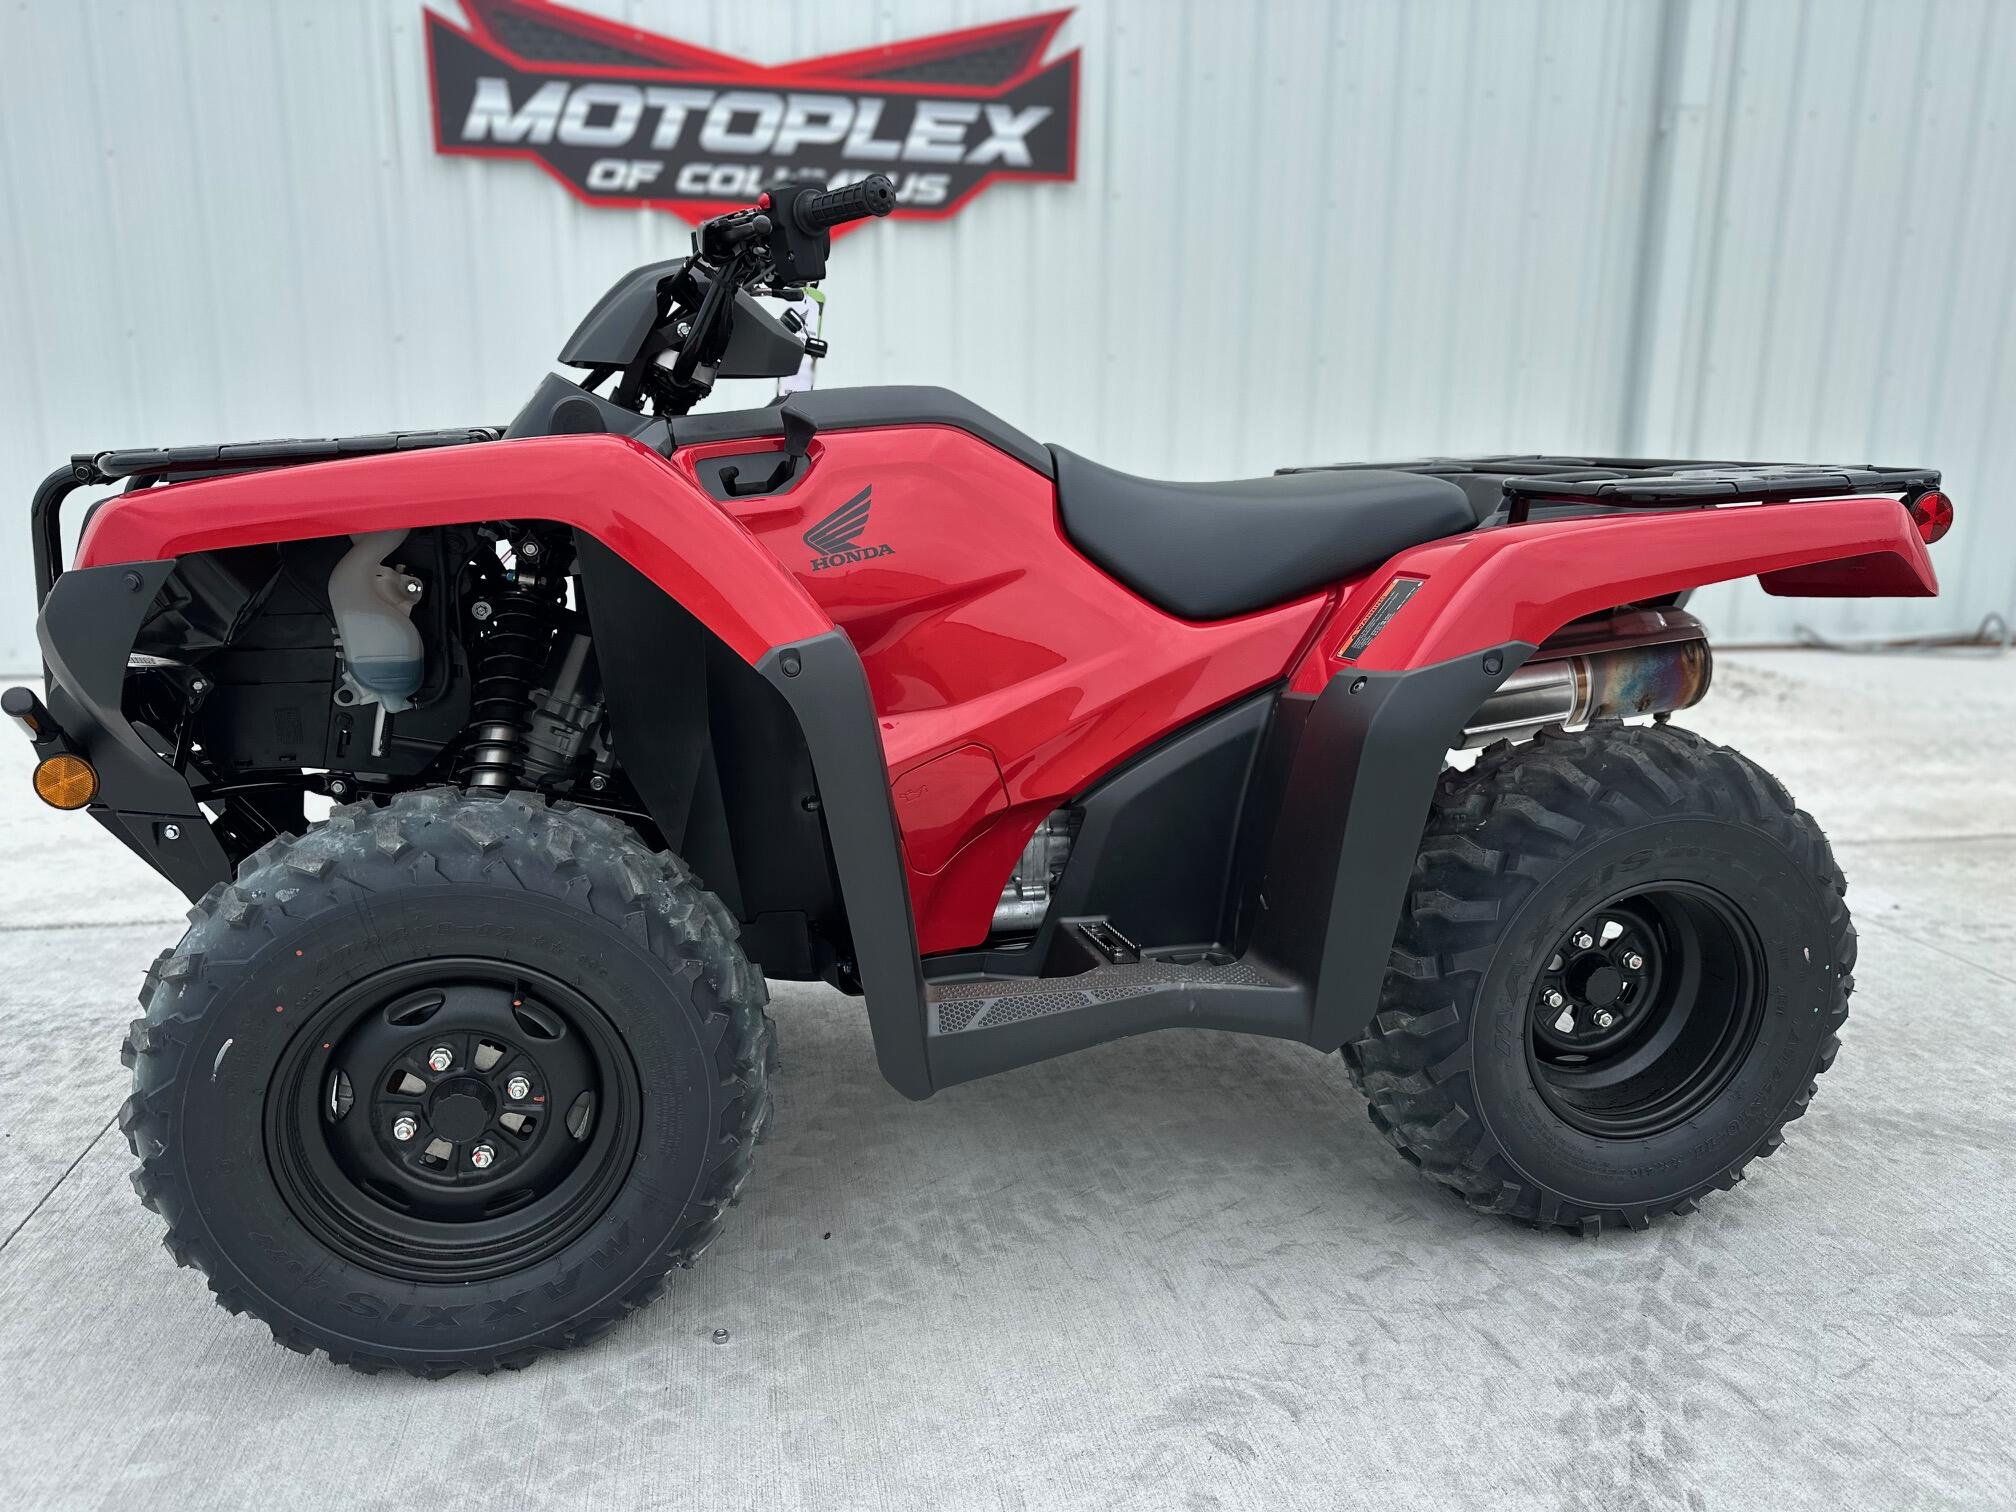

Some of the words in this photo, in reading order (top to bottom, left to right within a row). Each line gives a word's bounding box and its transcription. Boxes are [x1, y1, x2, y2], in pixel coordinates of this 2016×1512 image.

[461, 76, 1055, 167] MOTOPLEX
[586, 158, 664, 191] OF
[810, 543, 896, 572] HONDA
[336, 1220, 632, 1329] MAXXIS
